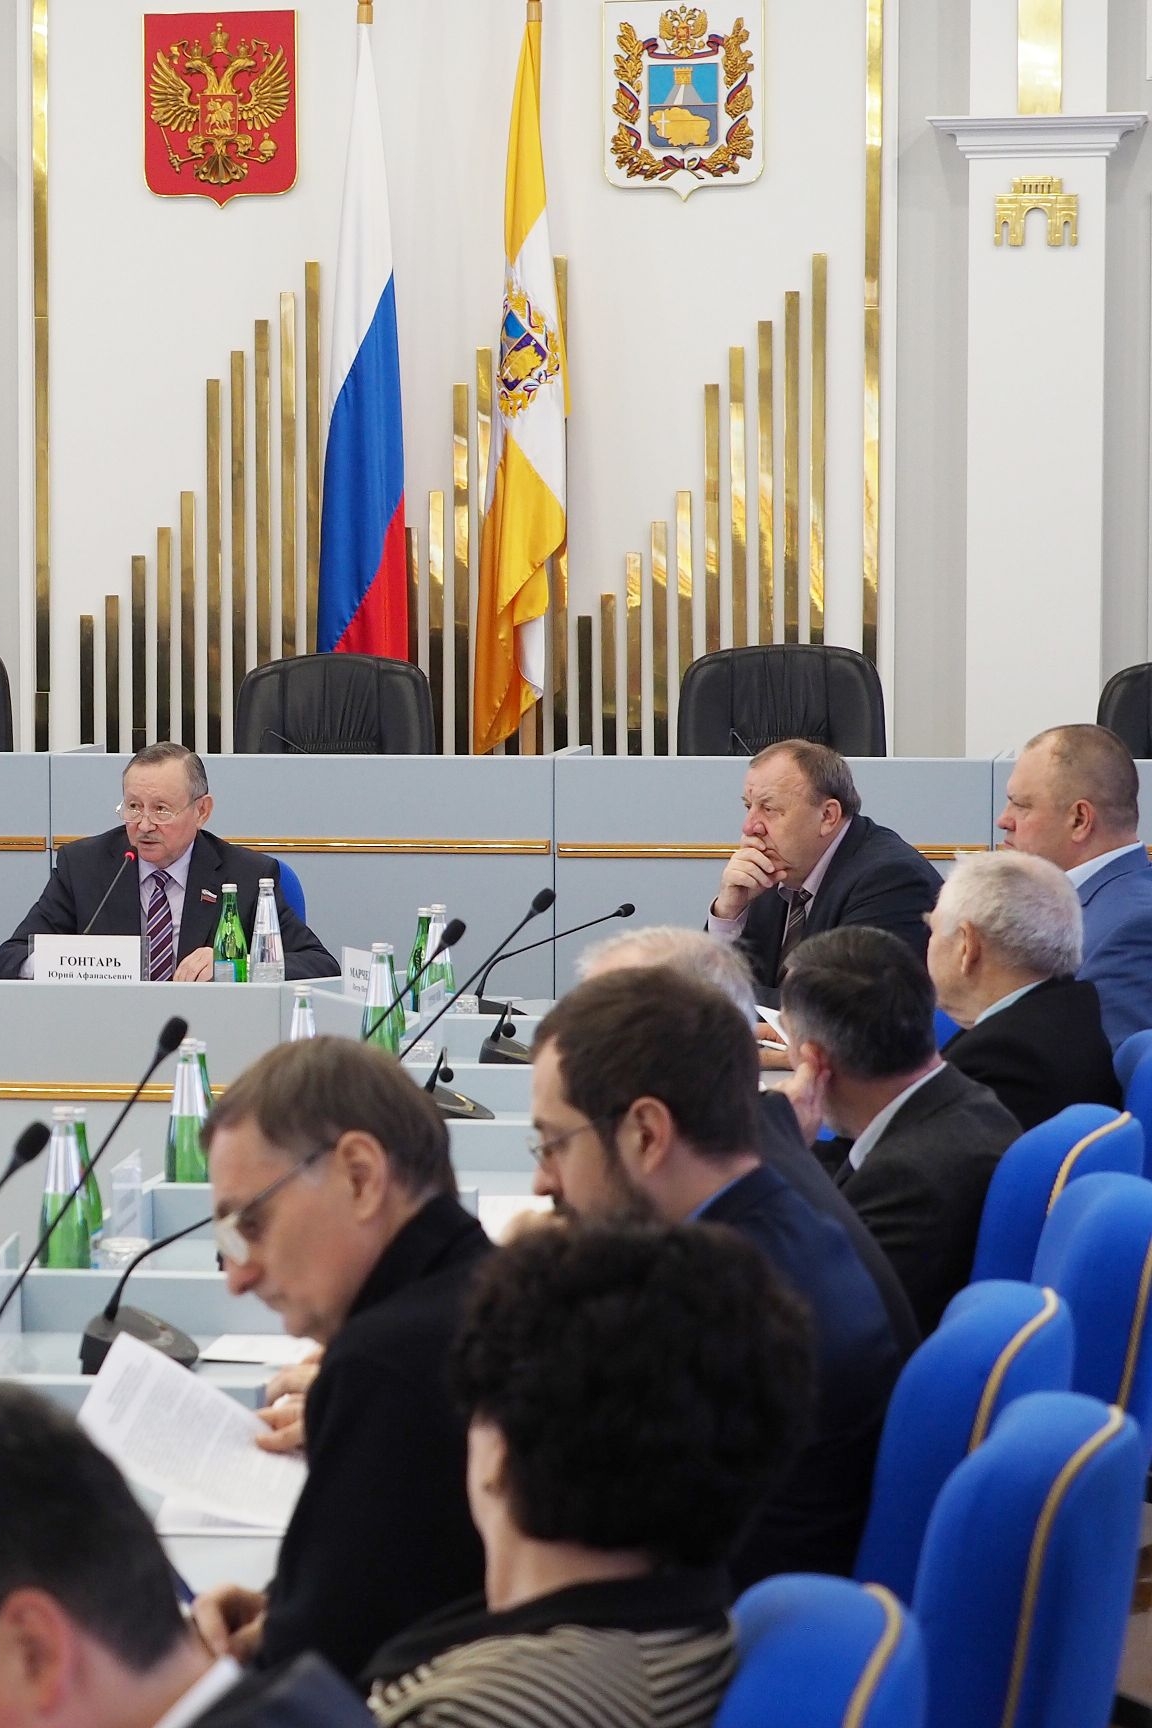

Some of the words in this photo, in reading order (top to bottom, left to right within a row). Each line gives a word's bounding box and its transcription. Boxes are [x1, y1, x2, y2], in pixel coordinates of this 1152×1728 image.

[59, 955, 122, 968] ГОНТАРЬ
[48, 970, 74, 980] Юрий
[76, 971, 133, 981] Афанасьевич
